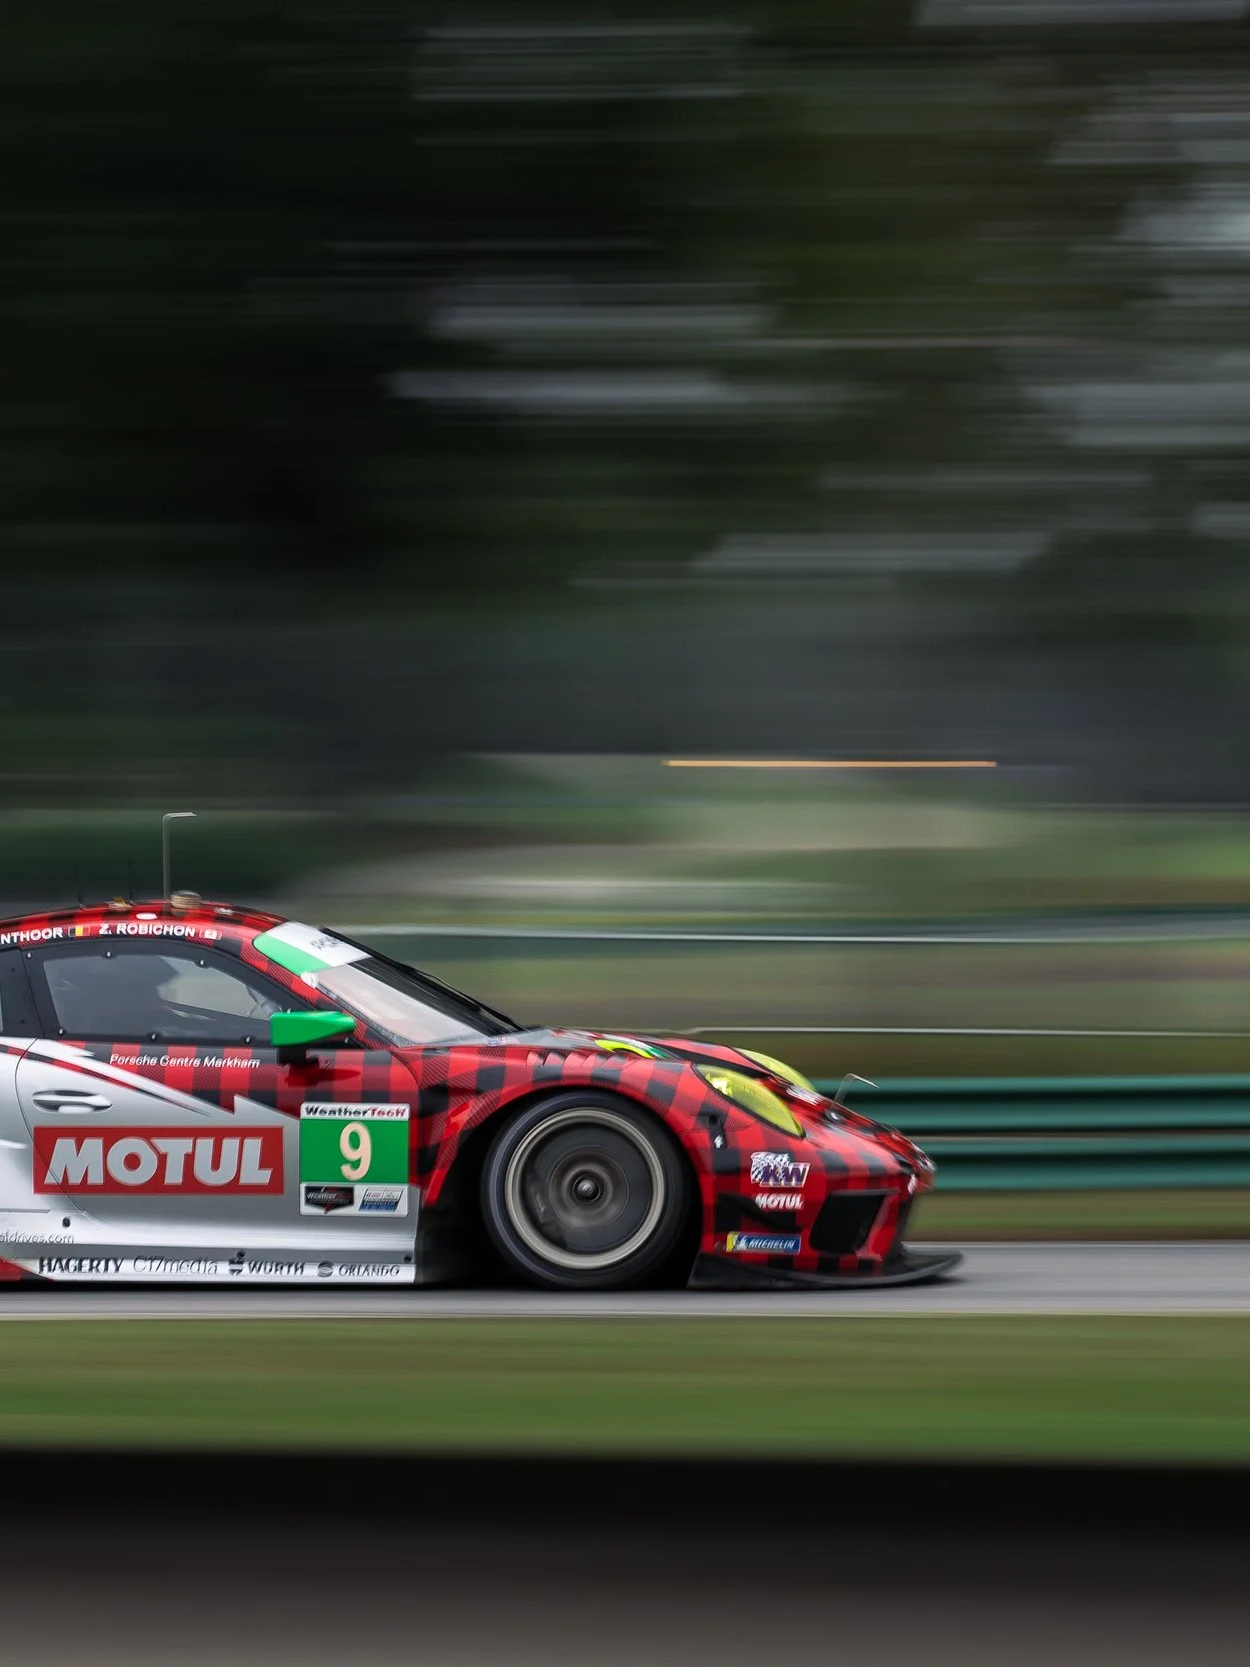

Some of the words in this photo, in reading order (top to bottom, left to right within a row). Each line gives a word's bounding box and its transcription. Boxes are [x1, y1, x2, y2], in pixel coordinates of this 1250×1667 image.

[116, 923, 196, 938] ROBICHON
[109, 1053, 157, 1067] Porsche
[159, 1054, 201, 1068] Centre
[203, 1056, 261, 1069] Markham
[305, 1105, 406, 1118] WeatherTech
[339, 1120, 373, 1182] 9
[44, 1136, 274, 1187] MOTUL
[754, 1192, 804, 1211] MOTUL
[748, 1239, 796, 1250] MICHELIN
[39, 1255, 124, 1275] HAGERTY
[338, 1263, 401, 1278] ORLANDO
